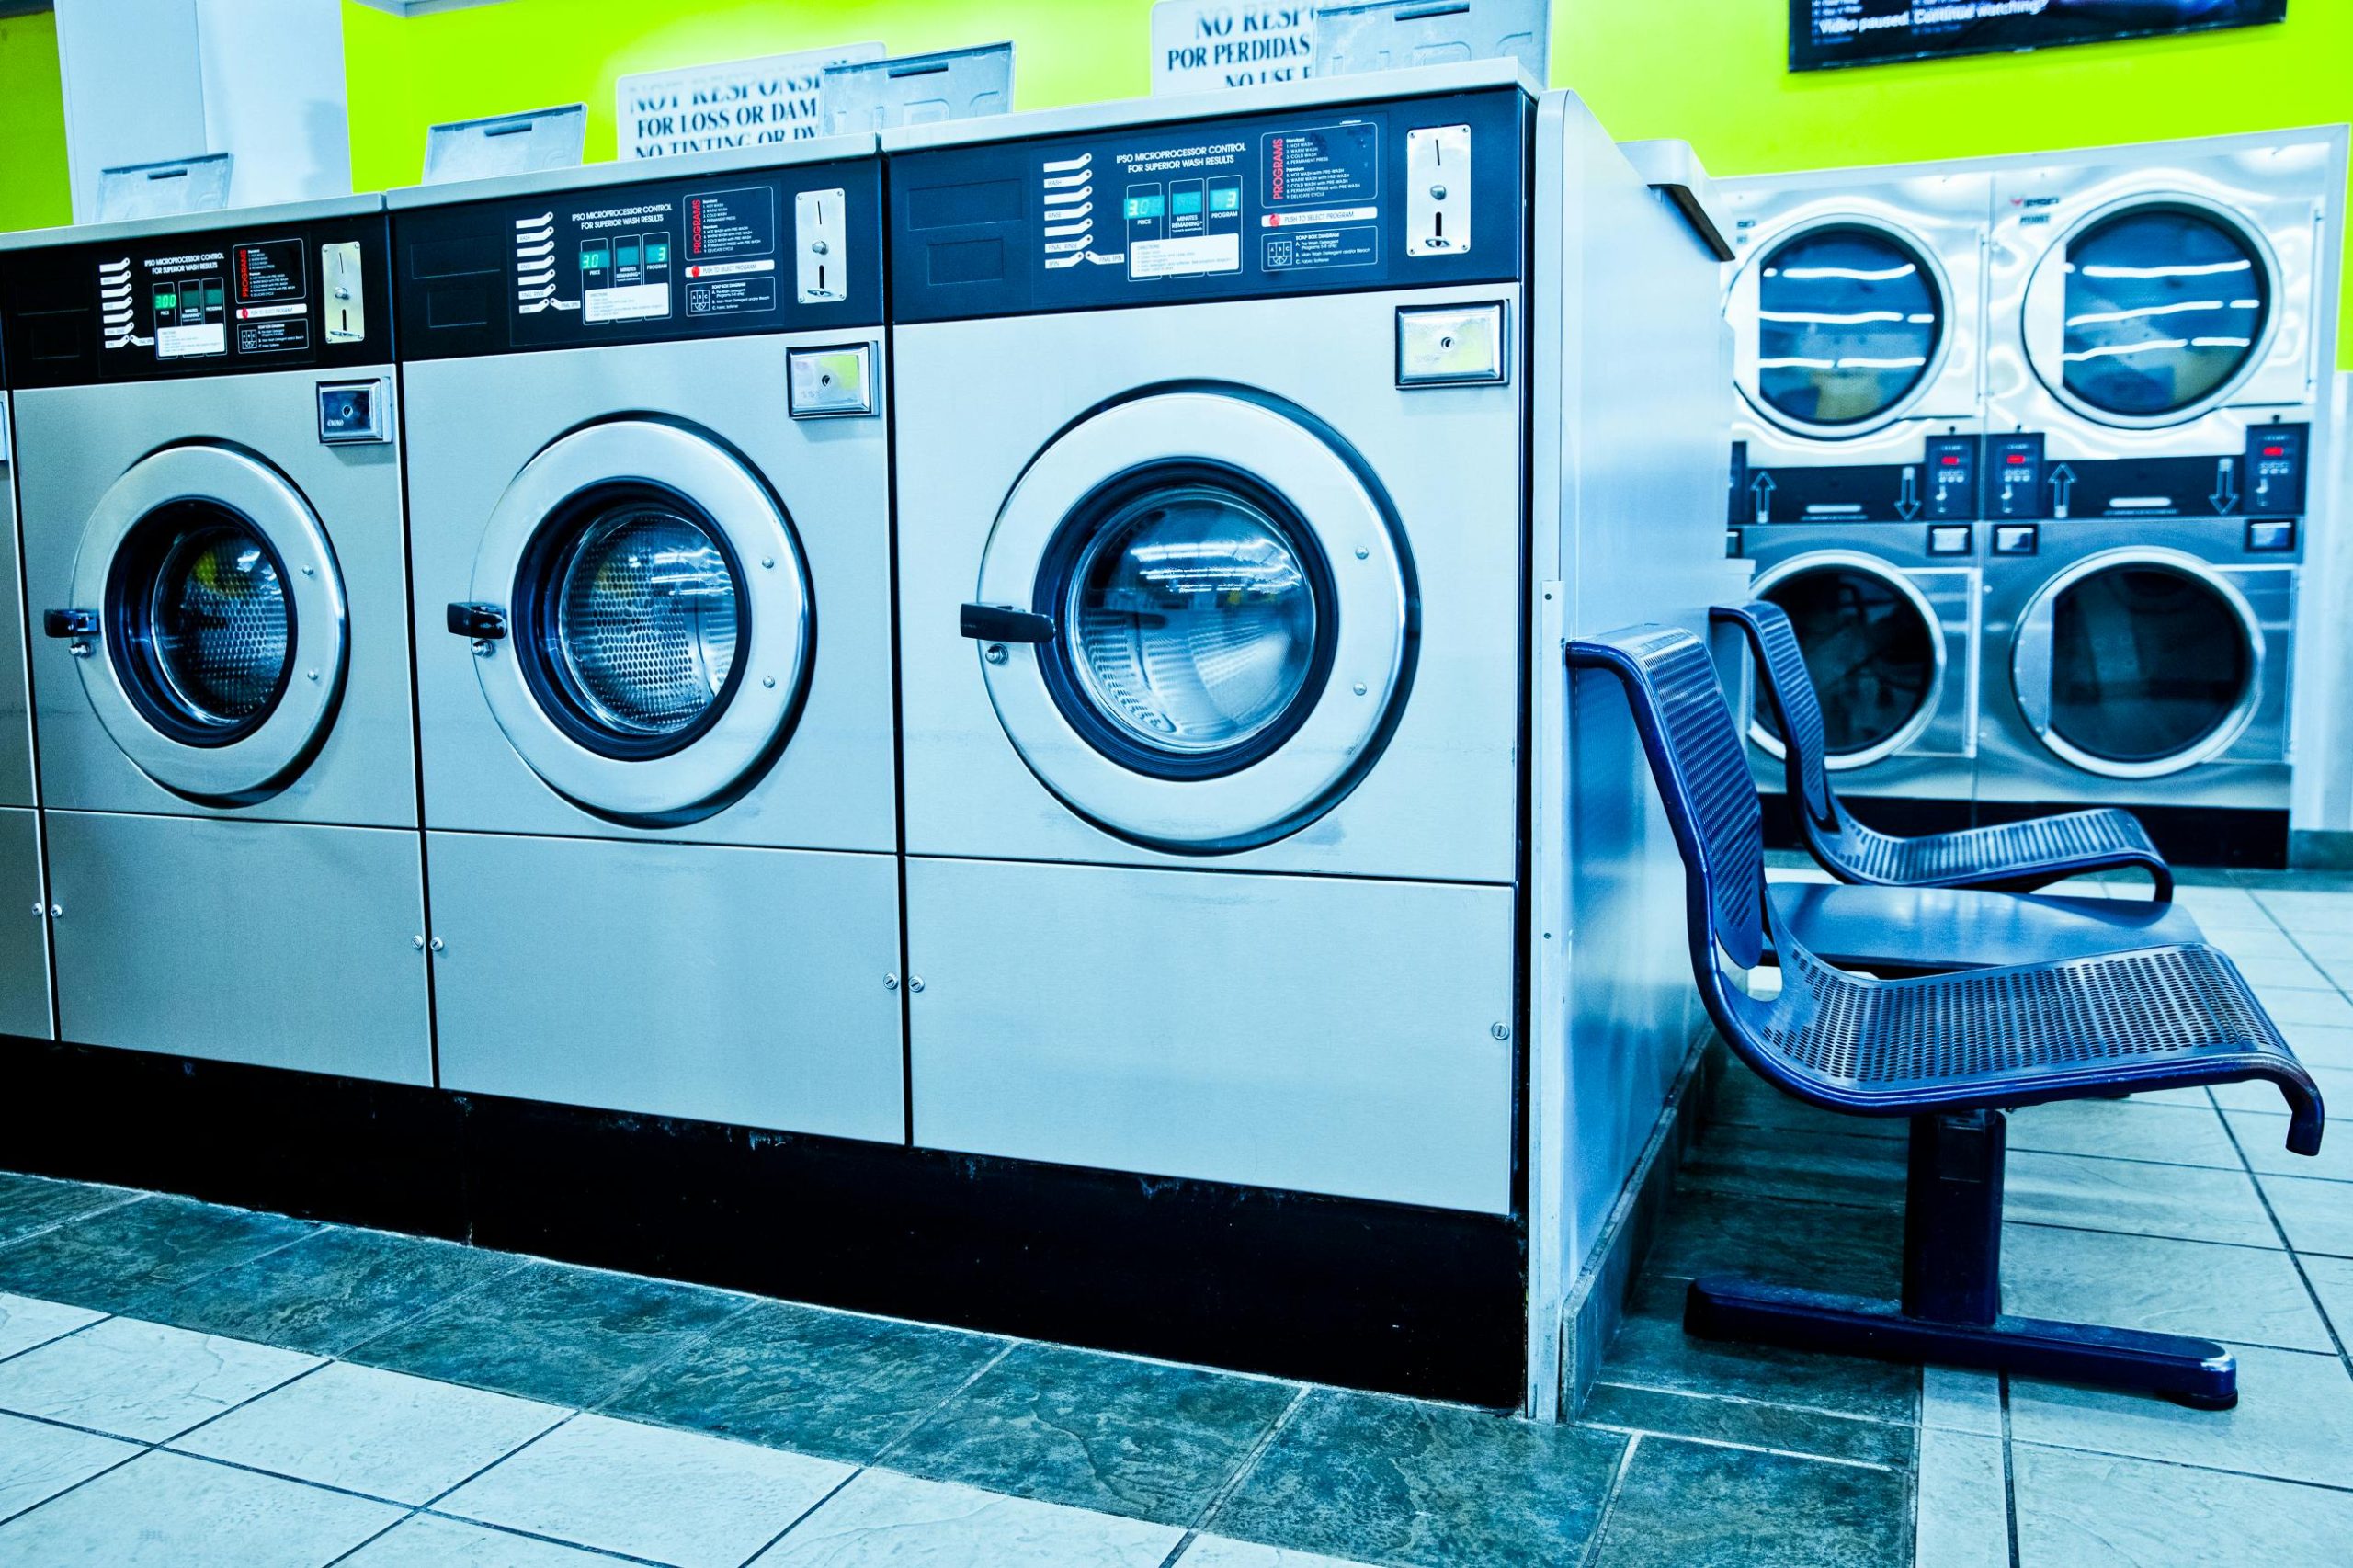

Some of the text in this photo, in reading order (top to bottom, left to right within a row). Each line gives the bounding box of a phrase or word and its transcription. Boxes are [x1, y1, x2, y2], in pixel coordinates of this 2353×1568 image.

[1196, 9, 1233, 39] NO
[1913, 6, 1975, 25] Continue
[1168, 35, 1311, 71] POR PERDIDAS
[638, 118, 673, 139] FOR
[682, 110, 729, 133] LOSS
[737, 106, 763, 125] OR
[1117, 142, 1246, 164] IPSO MICROPROCESSOR CONTROL
[1128, 154, 1234, 173] FOR SUPERIOR WASH RESULTS
[1273, 138, 1283, 199] PROGRAMS
[1226, 190, 1237, 208] 3
[572, 203, 673, 222] IPSO MICROPROCESSOR CONTROL
[581, 214, 664, 230] FOR SUPERIOR WASH RESULTS
[1211, 210, 1238, 219] PROGRAM
[1307, 213, 1325, 222] SELECT
[1327, 211, 1354, 220] PROGRAM
[692, 199, 701, 254] PROGRAMS
[658, 247, 666, 261] 3
